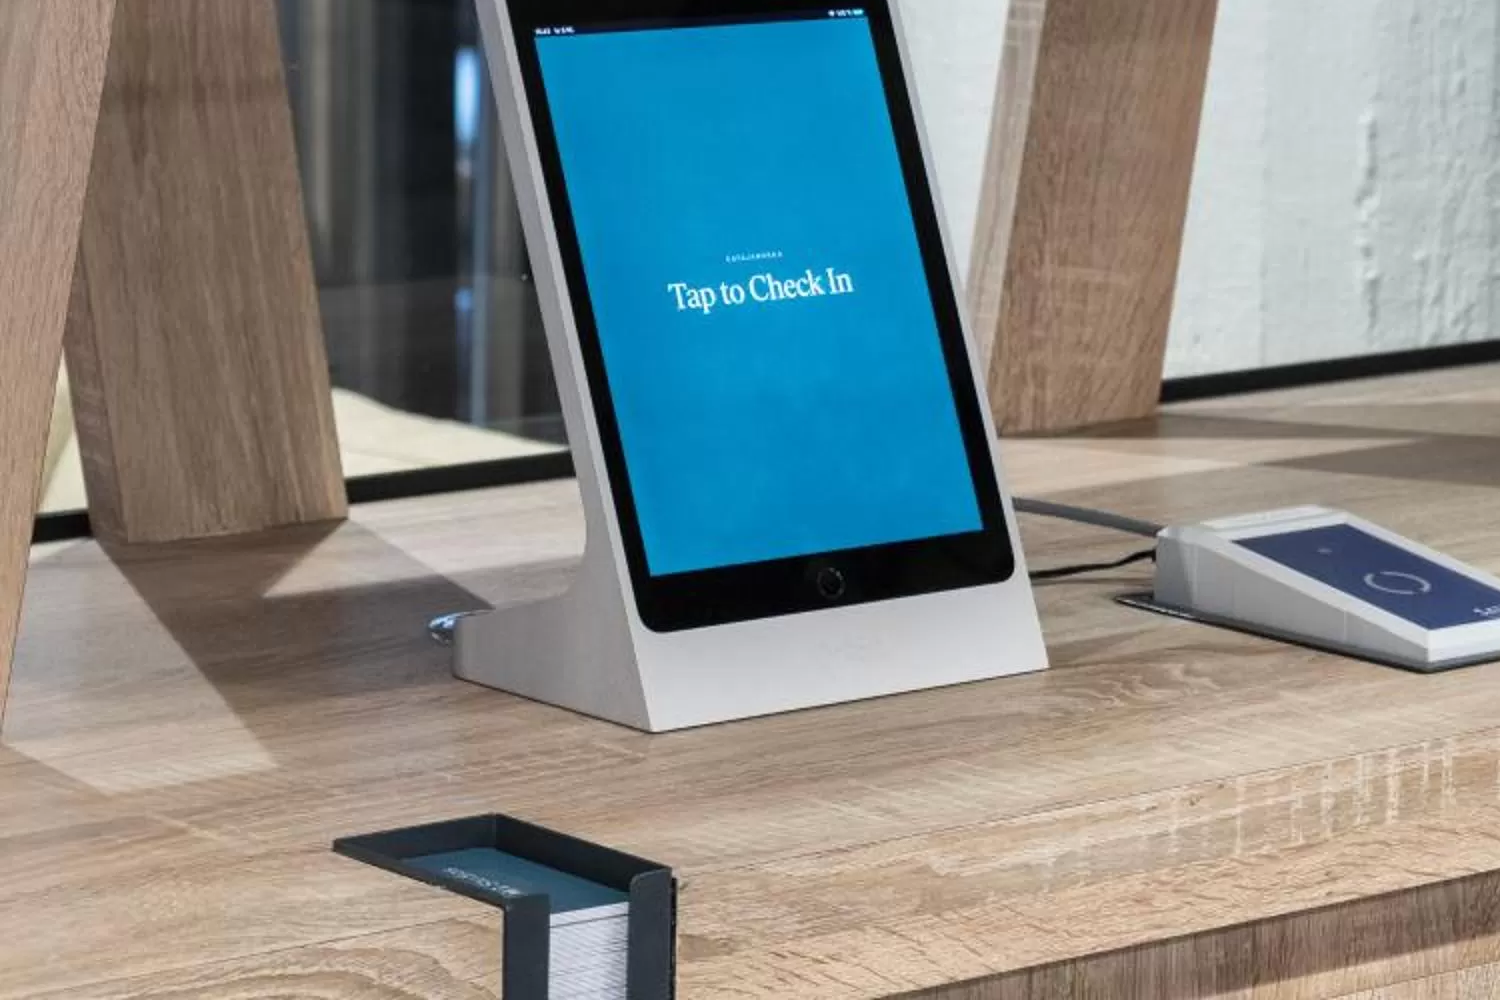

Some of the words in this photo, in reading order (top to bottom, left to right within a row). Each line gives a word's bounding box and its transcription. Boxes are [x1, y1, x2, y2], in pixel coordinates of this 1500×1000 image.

[667, 283, 717, 314] Tap
[720, 281, 745, 305] to
[749, 269, 825, 302] Check
[825, 267, 854, 295] In
